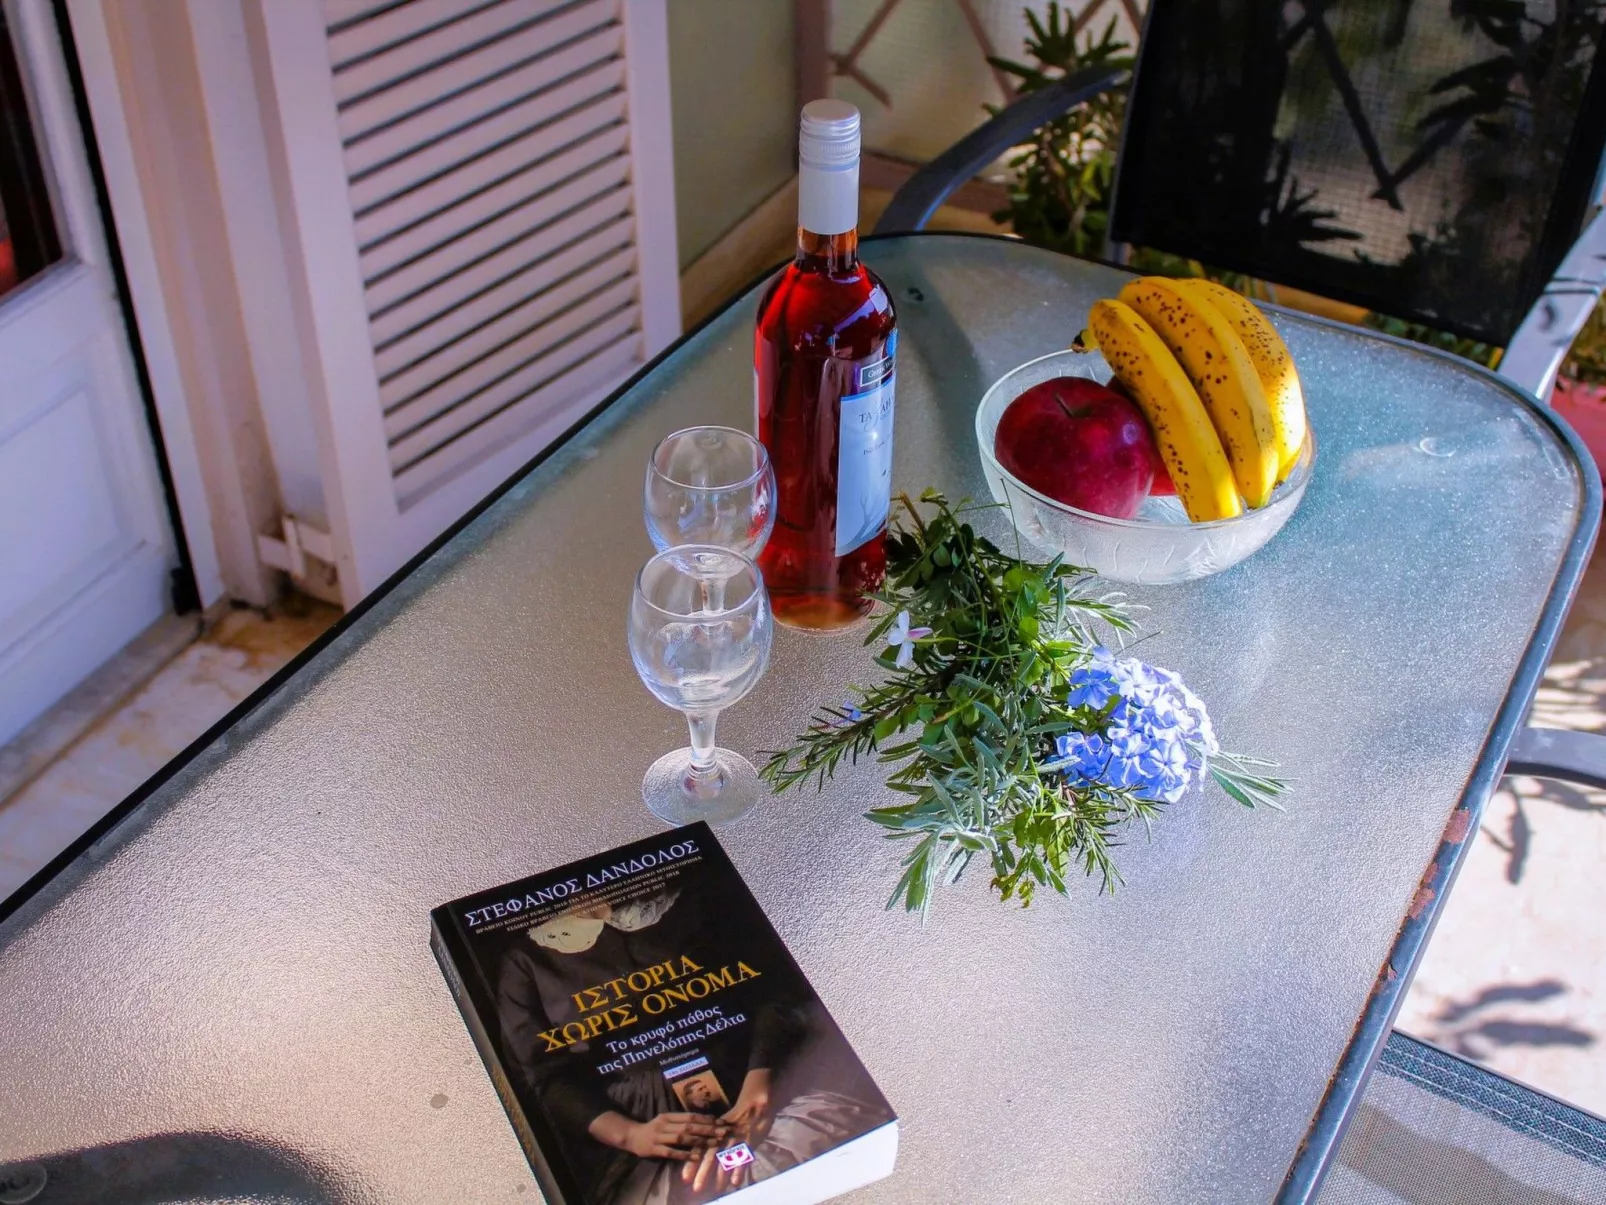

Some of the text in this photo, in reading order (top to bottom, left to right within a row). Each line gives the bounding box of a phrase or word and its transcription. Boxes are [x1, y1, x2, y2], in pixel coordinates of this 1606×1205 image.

[465, 878, 583, 927] ΣΤΕΦΑΝΟΣ
[587, 840, 700, 888] ΔΑΝΔΟΛΟΣ
[590, 881, 622, 896] ΚΑΛΥΤΕΡΟ
[623, 870, 656, 885] ΕΛΛΗΝΙΚΟ
[537, 960, 762, 1053] ΧΩΡΙΣ ΟΝΟΜΑ
[571, 954, 704, 1013] ΙΣΤΟΡΙΑ
[597, 1012, 747, 1075] της Πηνελόπης Δέλτα
[606, 1004, 723, 1054] Το κρυφό πάθος
